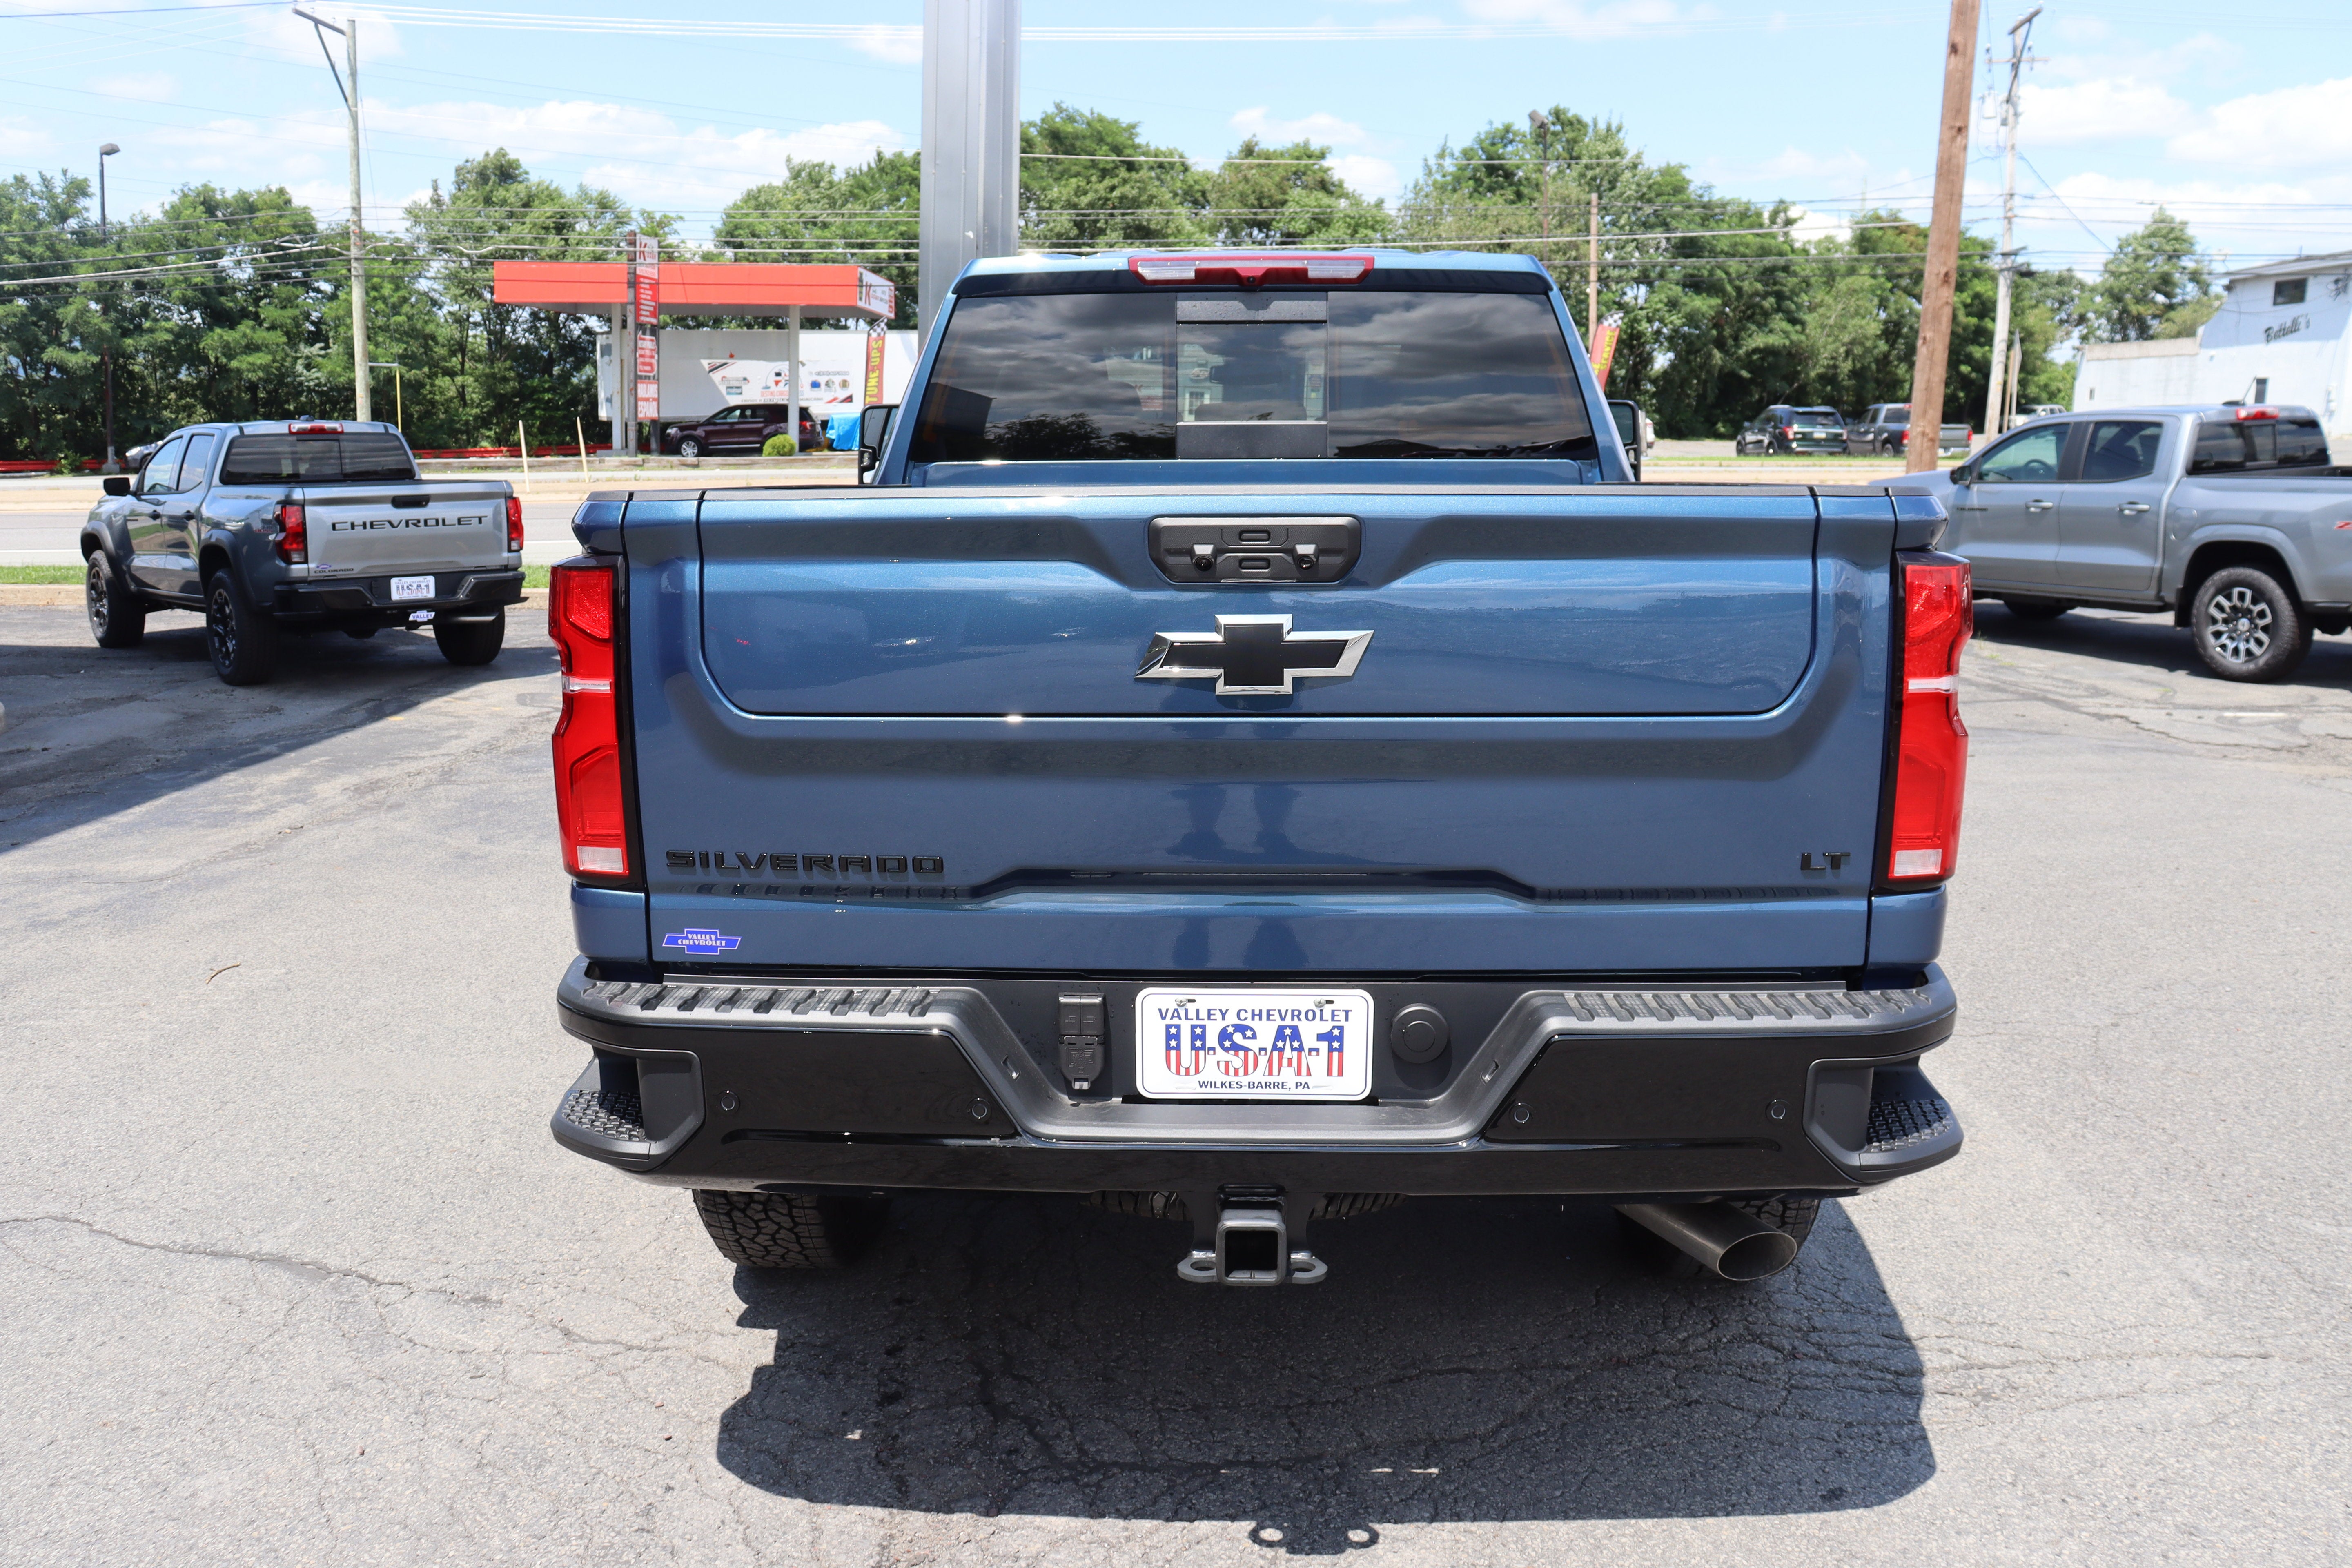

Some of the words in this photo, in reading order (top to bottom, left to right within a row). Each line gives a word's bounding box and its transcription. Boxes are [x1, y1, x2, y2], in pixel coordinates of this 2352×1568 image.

[1600, 330, 1616, 370] SERVICE
[865, 339, 883, 404] TUNE-UPS
[332, 515, 488, 531] CHEVROLET
[666, 849, 944, 874] SILVERADO
[1800, 852, 1851, 870] LT
[1158, 1008, 1230, 1021] VALLEY
[1236, 1008, 1352, 1022] CHEVROLET
[1198, 1080, 1292, 1091] WILKES-BARRE,
[1295, 1082, 1311, 1090] PA
